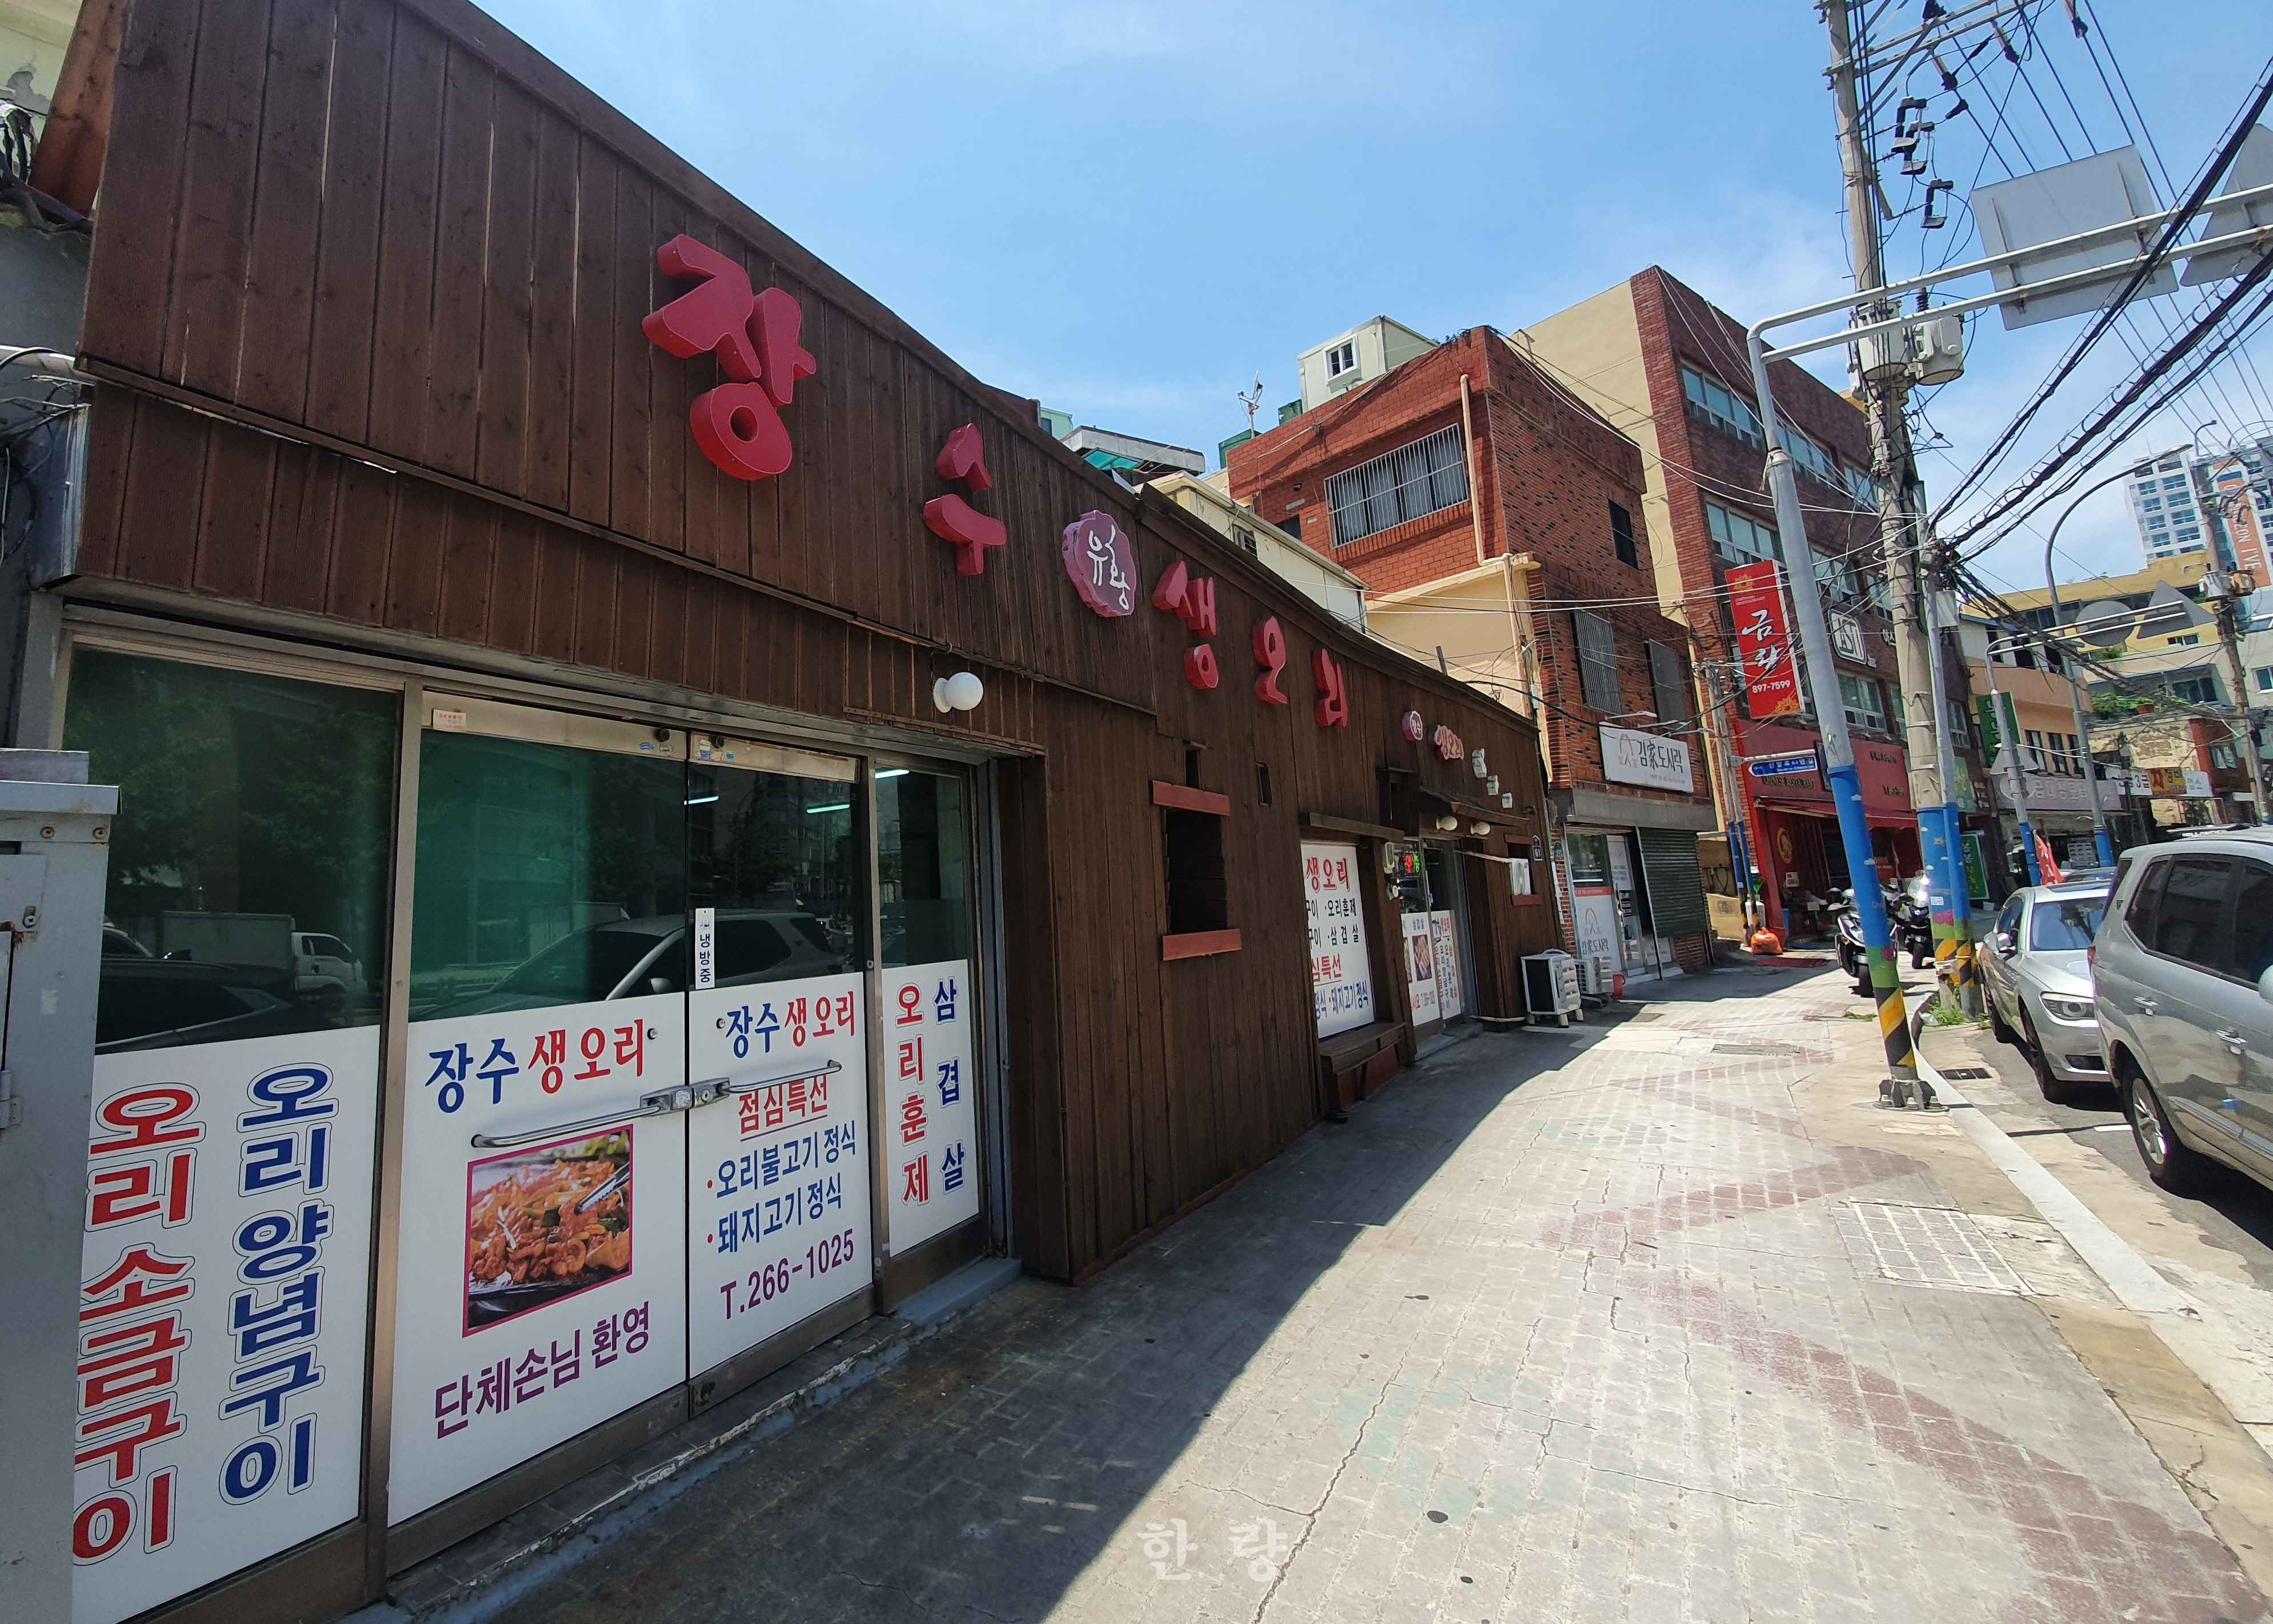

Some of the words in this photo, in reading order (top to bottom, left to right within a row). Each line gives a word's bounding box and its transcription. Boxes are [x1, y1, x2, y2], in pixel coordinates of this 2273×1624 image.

[1752, 680, 1791, 693] 897-7599
[1306, 857, 1350, 893] 생오리
[1328, 898, 1356, 918] 오리훈제
[699, 934, 711, 983] 냉방중
[738, 1074, 829, 1135] 점심특선
[715, 1136, 820, 1199] 오리불고기
[823, 1119, 857, 1163] 정식
[718, 1186, 802, 1254] 돼지고기
[806, 1171, 843, 1222] 정식
[720, 1228, 855, 1320] T.266-1025
[434, 1330, 582, 1439] 단체손님
[592, 1301, 651, 1365] 환영
